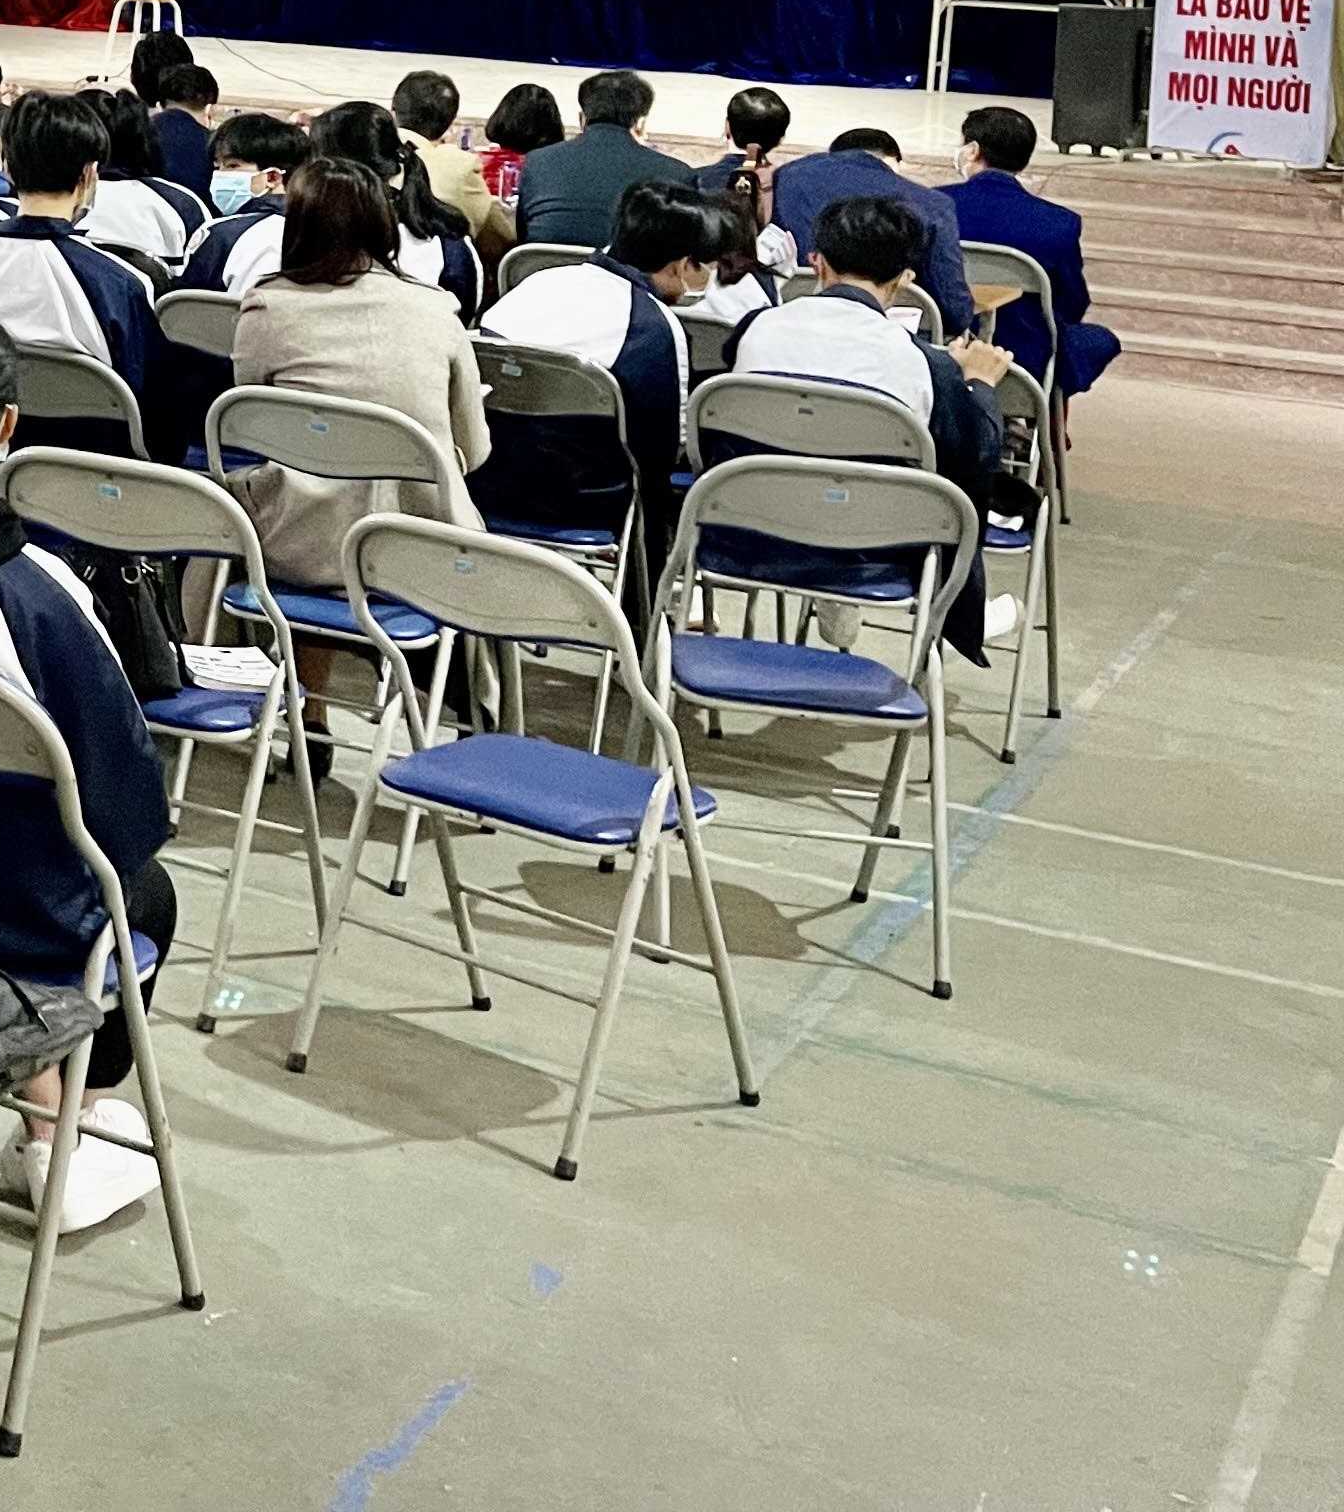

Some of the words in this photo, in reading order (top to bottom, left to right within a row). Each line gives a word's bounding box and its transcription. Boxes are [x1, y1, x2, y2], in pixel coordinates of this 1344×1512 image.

[1184, 25, 1256, 64] MÌNH
[1265, 30, 1299, 68] VÀ
[1168, 71, 1218, 110] MỌI
[1227, 74, 1312, 114] NGƯỜI
